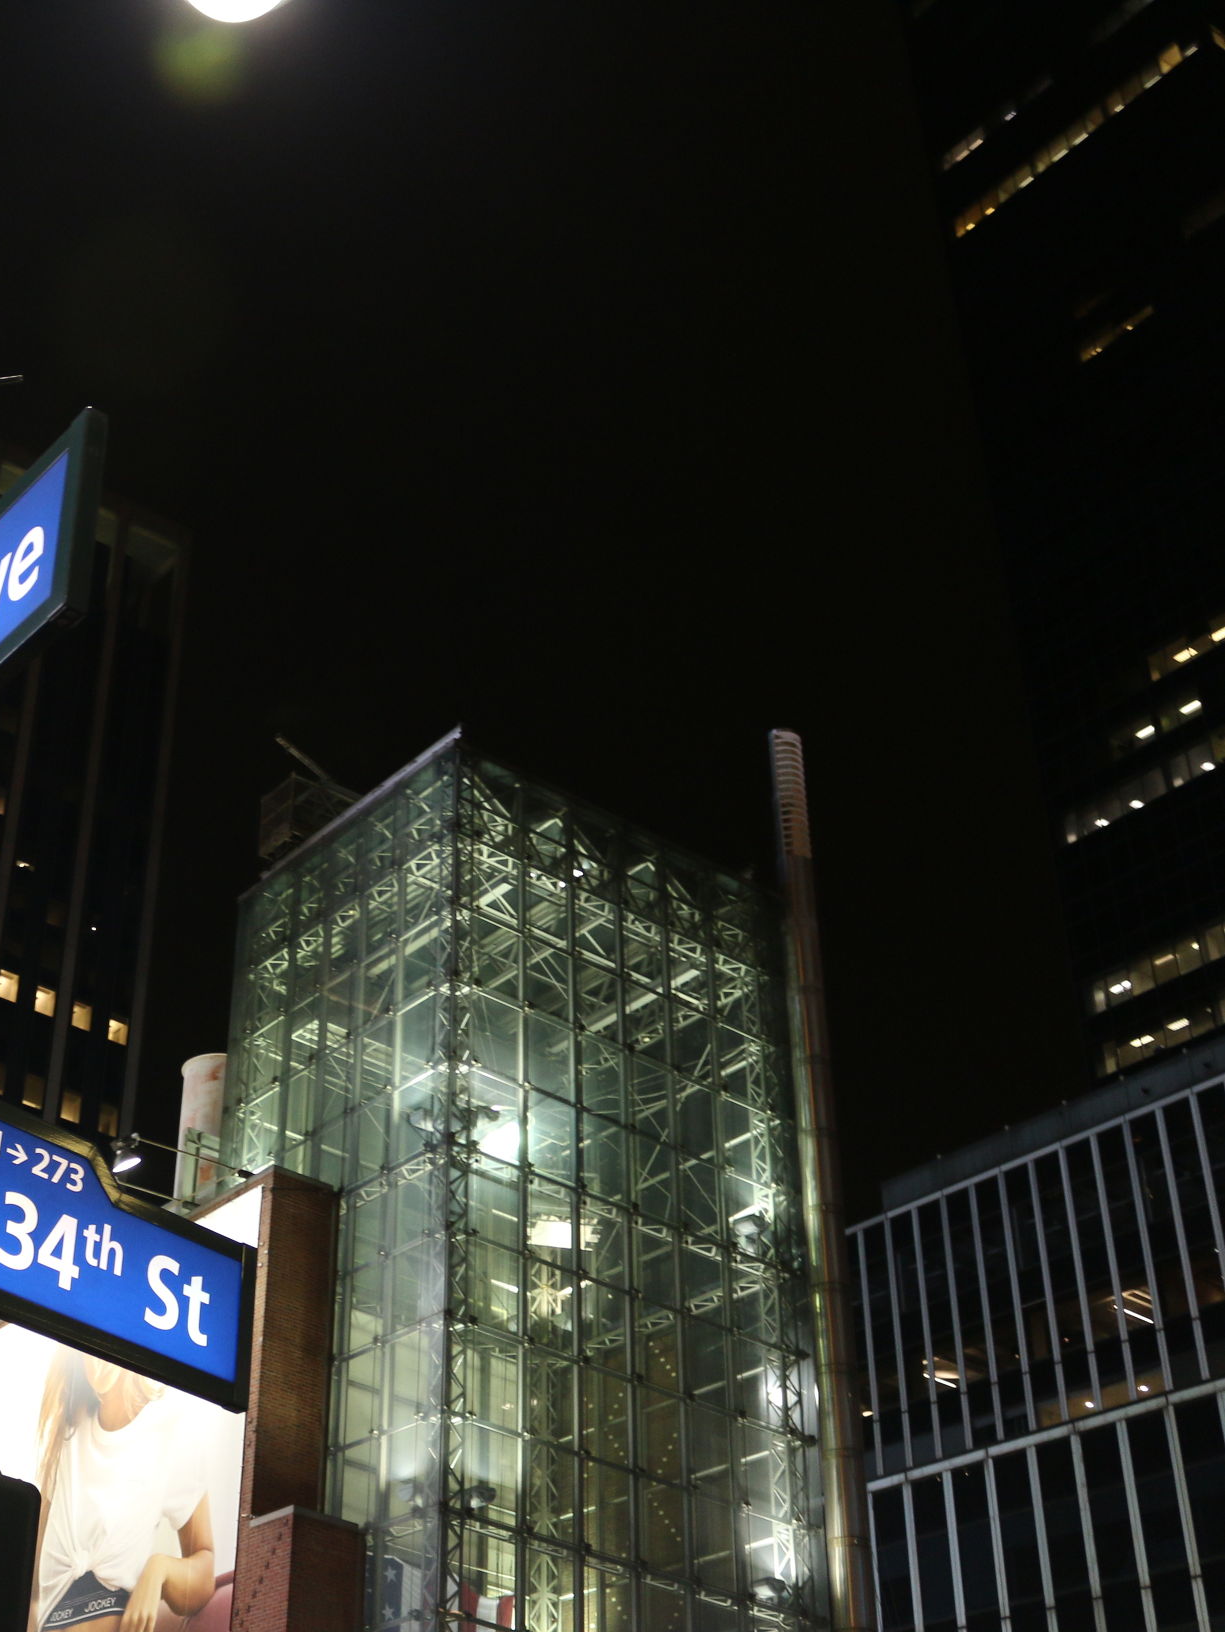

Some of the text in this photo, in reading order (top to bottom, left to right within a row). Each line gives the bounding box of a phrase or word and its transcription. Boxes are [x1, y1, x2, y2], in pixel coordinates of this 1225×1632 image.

[30, 1147, 86, 1193] 273
[143, 1254, 211, 1347] St
[84, 1597, 117, 1613] JOCKEY
